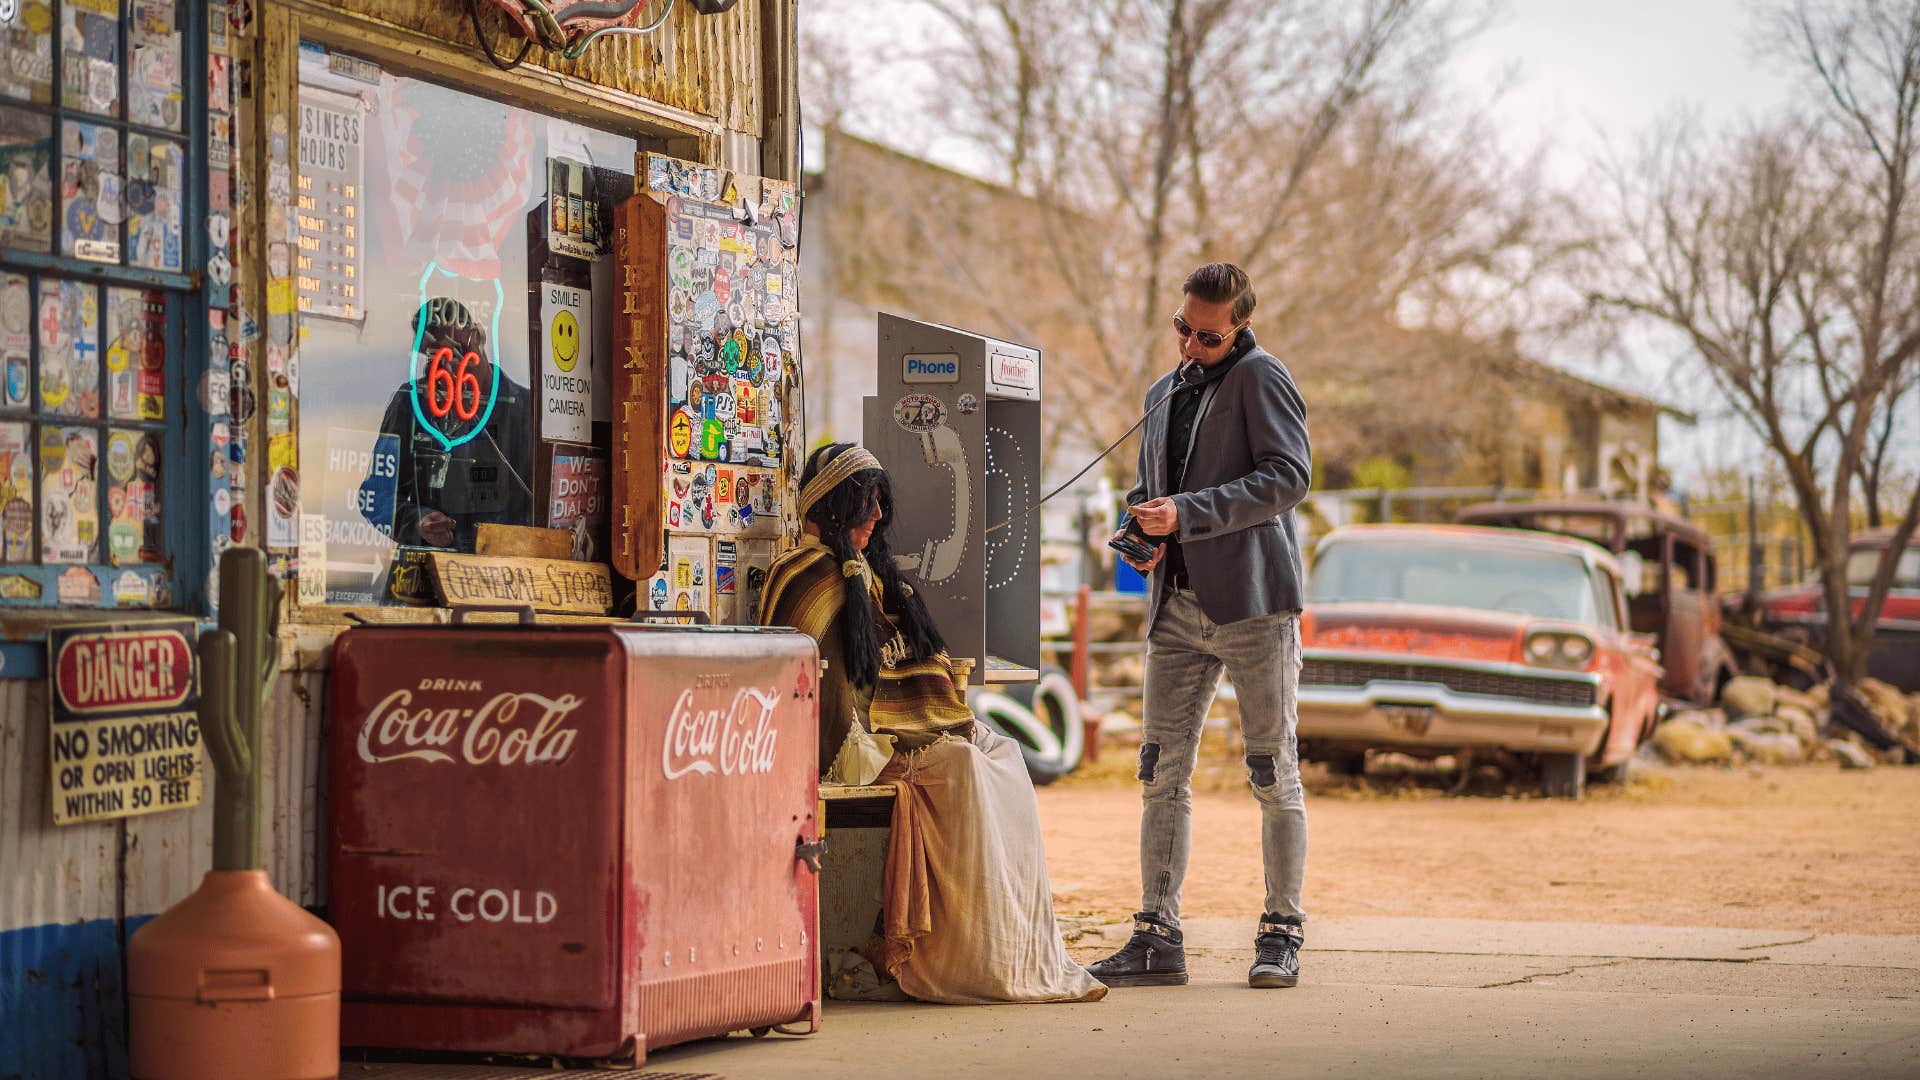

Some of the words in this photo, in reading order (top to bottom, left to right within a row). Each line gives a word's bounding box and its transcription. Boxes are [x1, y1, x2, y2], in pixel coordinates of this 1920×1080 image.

[300, 137, 346, 171] HOURS
[428, 297, 492, 330] ROUTE
[551, 290, 581, 308] SMILE!
[908, 359, 956, 374] Phone
[428, 345, 480, 421] 66
[544, 373, 575, 394] YOU'RE
[576, 378, 591, 396] ON
[549, 398, 586, 418] CAMERA
[329, 447, 396, 477] HIPPIES
[569, 455, 593, 473] WE
[347, 489, 376, 512] USE
[558, 477, 600, 497] DON'T
[553, 500, 582, 519] DIAL
[586, 495, 606, 514] 911
[325, 520, 393, 547] BACKDOOR
[445, 558, 545, 603] GENERAL
[548, 563, 610, 607] STORE
[75, 639, 176, 704] DANGER
[418, 678, 483, 692] DRINK
[53, 728, 90, 763] NO
[96, 719, 200, 757] SMOKING
[357, 689, 587, 766] Coca-Cola
[662, 687, 783, 780] Coca-Cola
[61, 765, 84, 791] OR
[93, 760, 136, 786] OPEN
[144, 753, 195, 781] LIGHTS
[65, 790, 125, 818] WITHIN
[131, 786, 152, 809] 50
[160, 782, 191, 804] FEET
[377, 886, 437, 920] ICE
[450, 889, 558, 923] COLD
